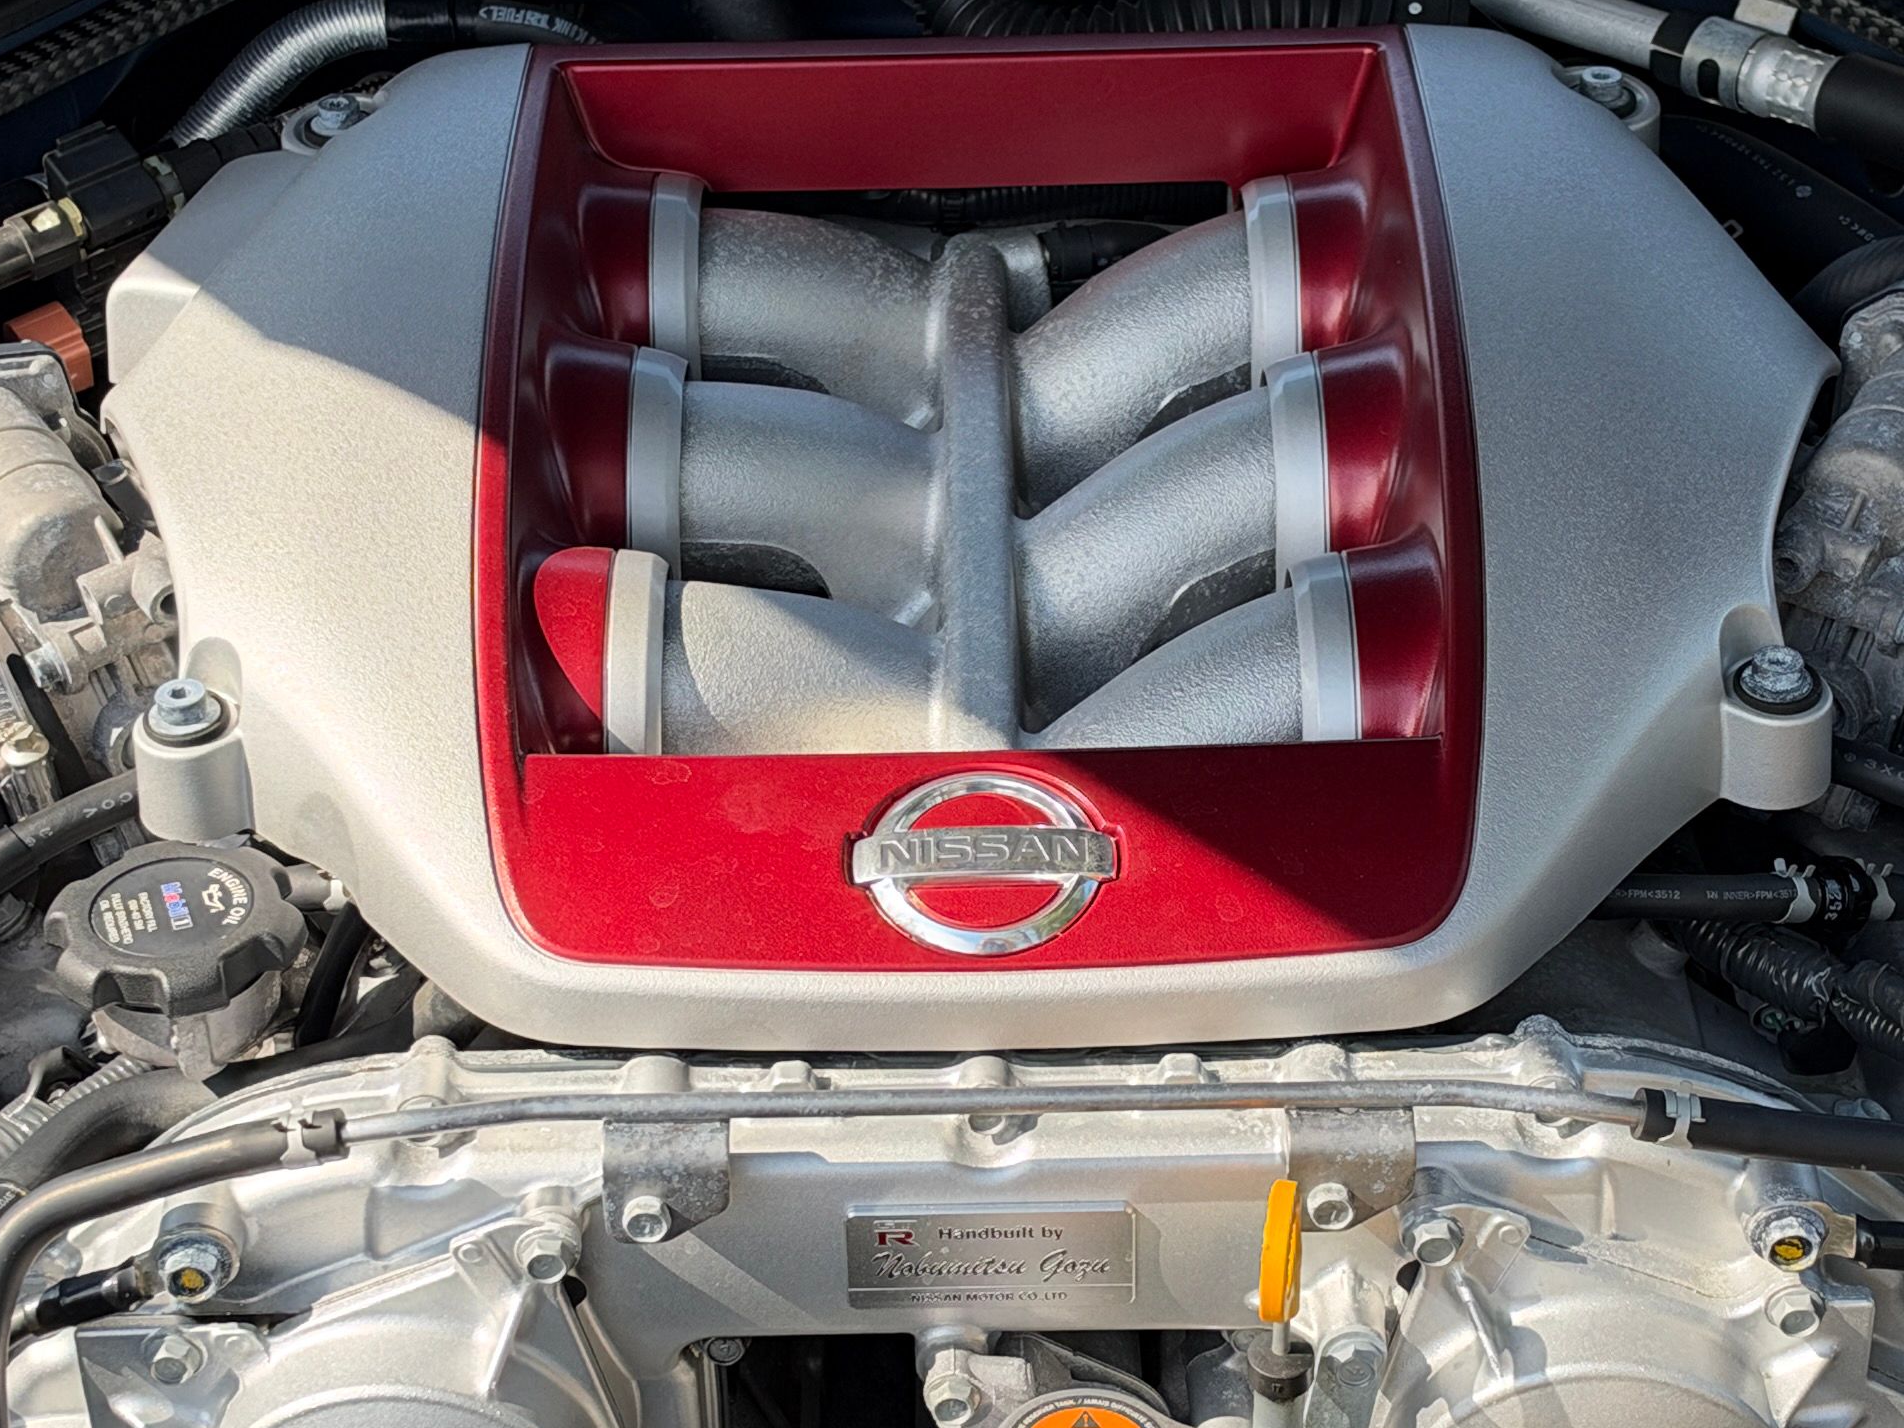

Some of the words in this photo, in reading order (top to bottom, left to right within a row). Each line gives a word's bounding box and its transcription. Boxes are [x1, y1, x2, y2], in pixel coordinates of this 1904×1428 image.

[880, 834, 1090, 869] NISSAN
[207, 867, 248, 906] ENGINE
[160, 881, 187, 920] Mobil
[220, 905, 248, 926] OIL
[874, 1228, 920, 1247] R
[938, 1224, 1035, 1242] Handbuilt
[1041, 1225, 1064, 1243] by
[871, 1251, 1028, 1278] Nobumitsu
[1039, 1249, 1112, 1281] Gozu
[910, 1292, 963, 1304] NISSAN
[967, 1291, 1016, 1302] MOTOR
